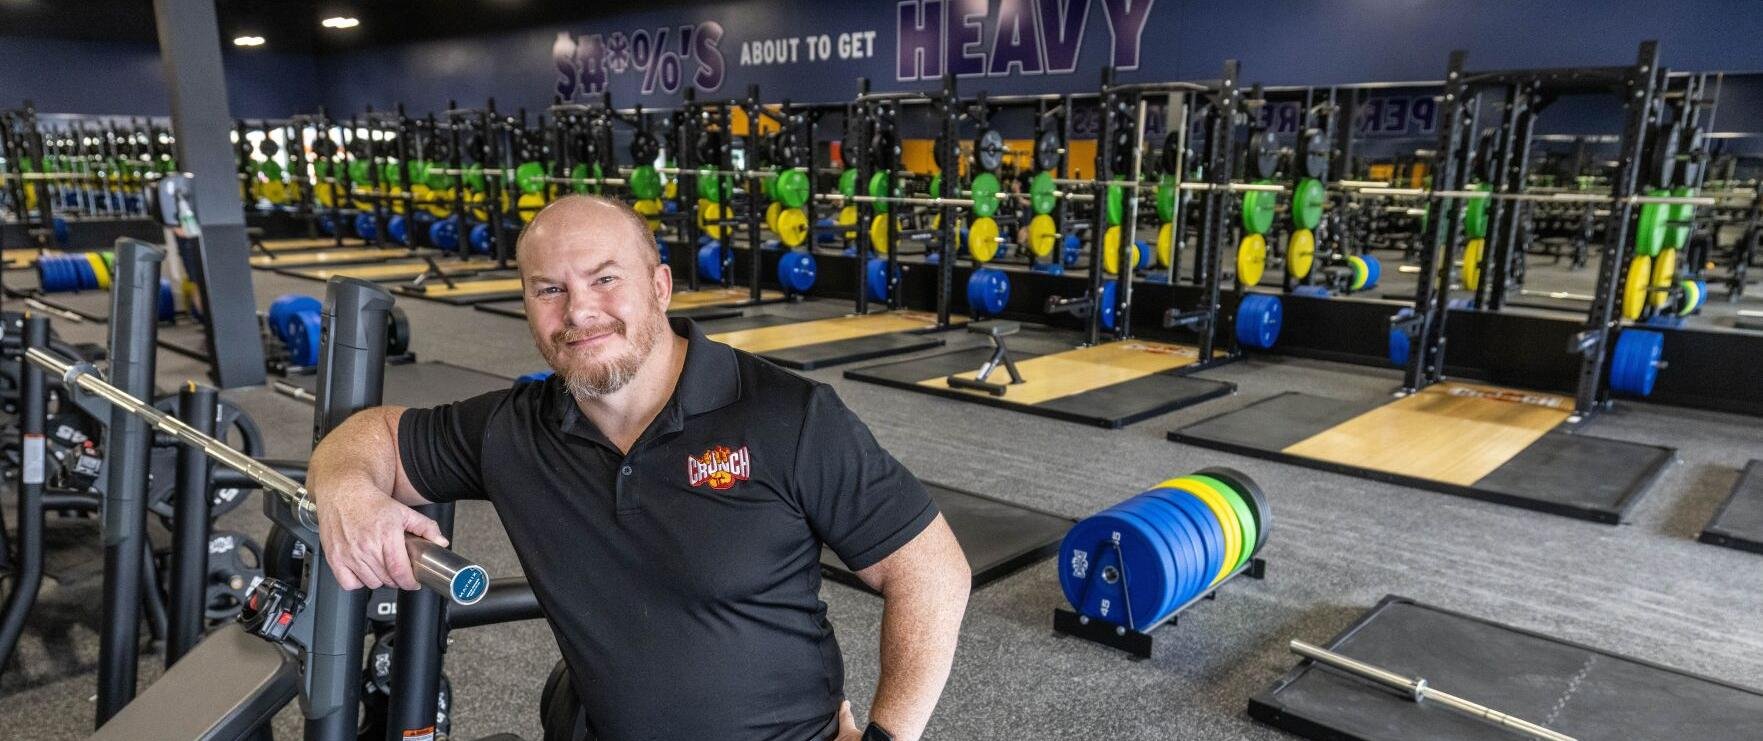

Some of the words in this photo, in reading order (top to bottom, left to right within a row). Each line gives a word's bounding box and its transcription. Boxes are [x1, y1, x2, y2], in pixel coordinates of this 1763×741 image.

[740, 40, 800, 65] ABOUT
[806, 35, 831, 61] TO
[838, 31, 876, 58] GET
[897, 0, 1153, 81] HEAVY
[687, 446, 750, 485] CRUNCH
[459, 572, 477, 598] MATRIX
[1100, 599, 1110, 616] 45
